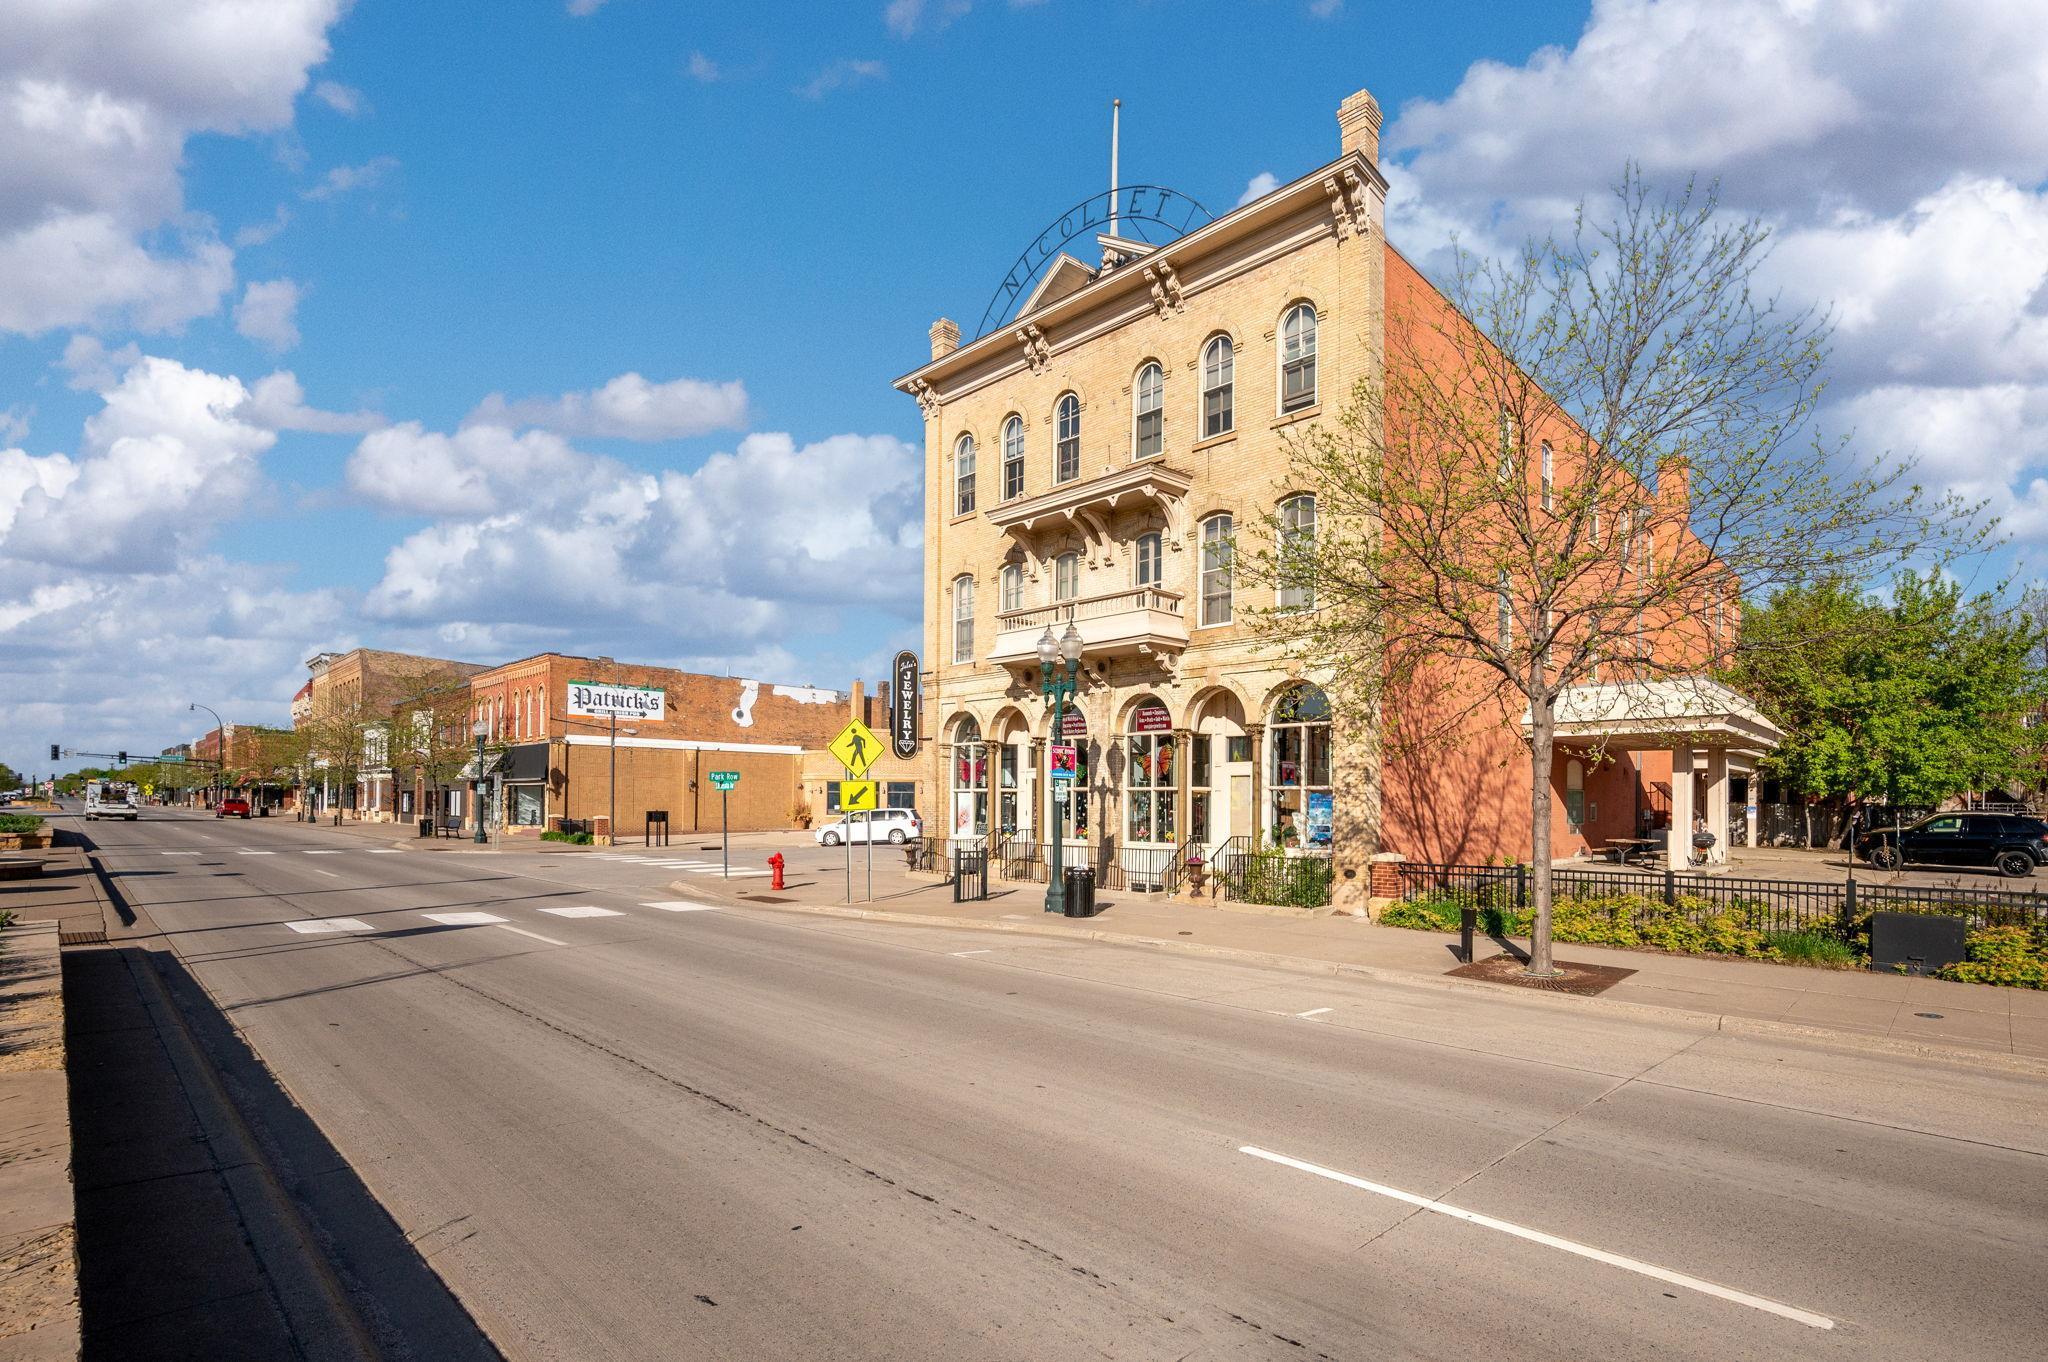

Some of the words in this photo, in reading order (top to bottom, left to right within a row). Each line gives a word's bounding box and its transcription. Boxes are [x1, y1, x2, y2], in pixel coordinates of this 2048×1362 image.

[1004, 188, 1171, 297] NICOLLET
[573, 686, 660, 711] Patrick's
[901, 671, 914, 740] JEWELRY
